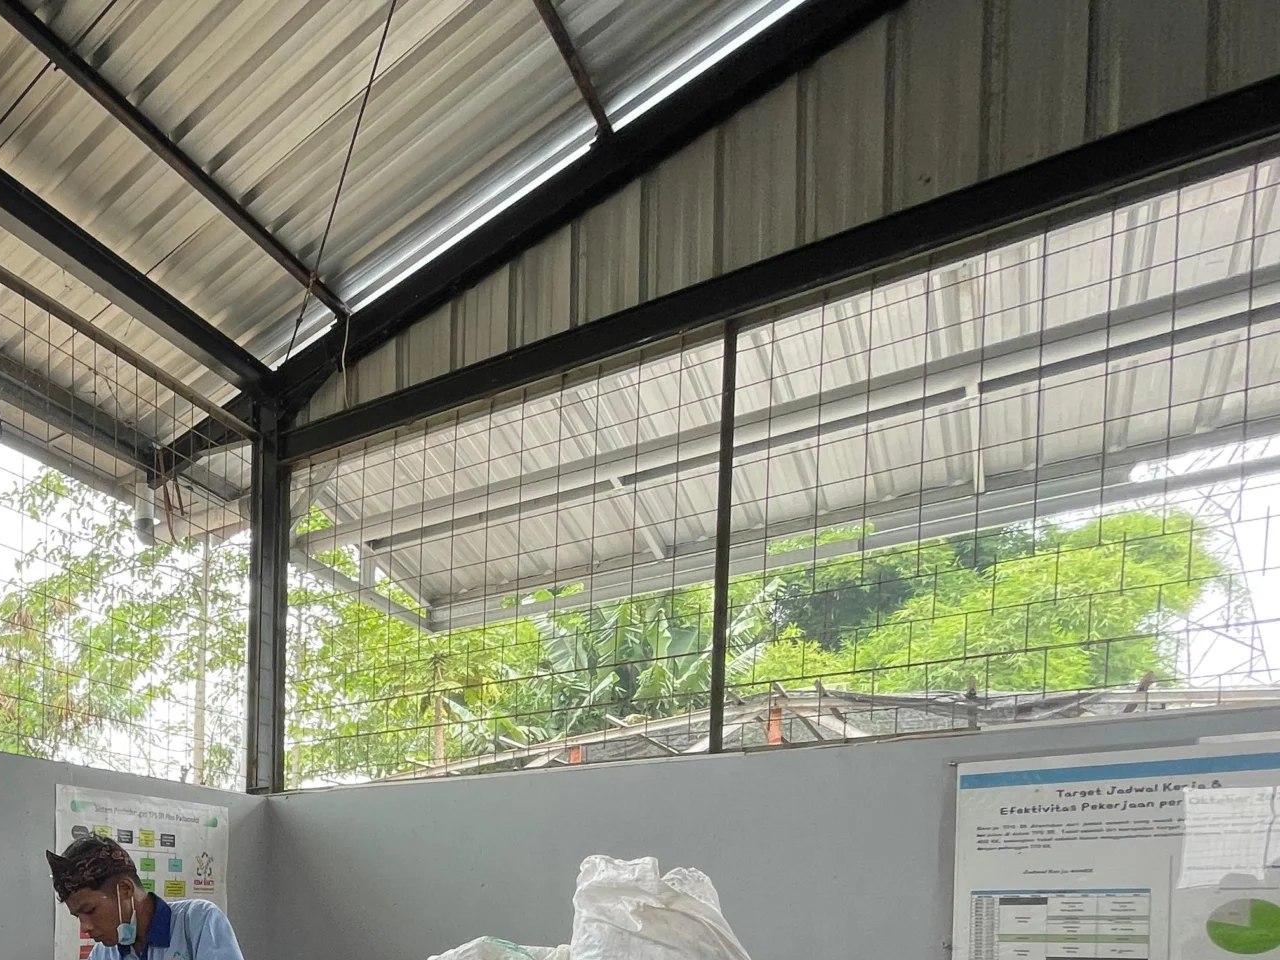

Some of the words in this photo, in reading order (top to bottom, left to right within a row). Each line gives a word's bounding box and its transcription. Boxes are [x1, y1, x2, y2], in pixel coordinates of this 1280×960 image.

[1056, 787, 1102, 798] Target
[1107, 783, 1158, 796] Jadwal
[1000, 804, 1077, 815] Efektivitas
[1081, 801, 1154, 811] Pekerjaan
[1159, 800, 1183, 808] per
